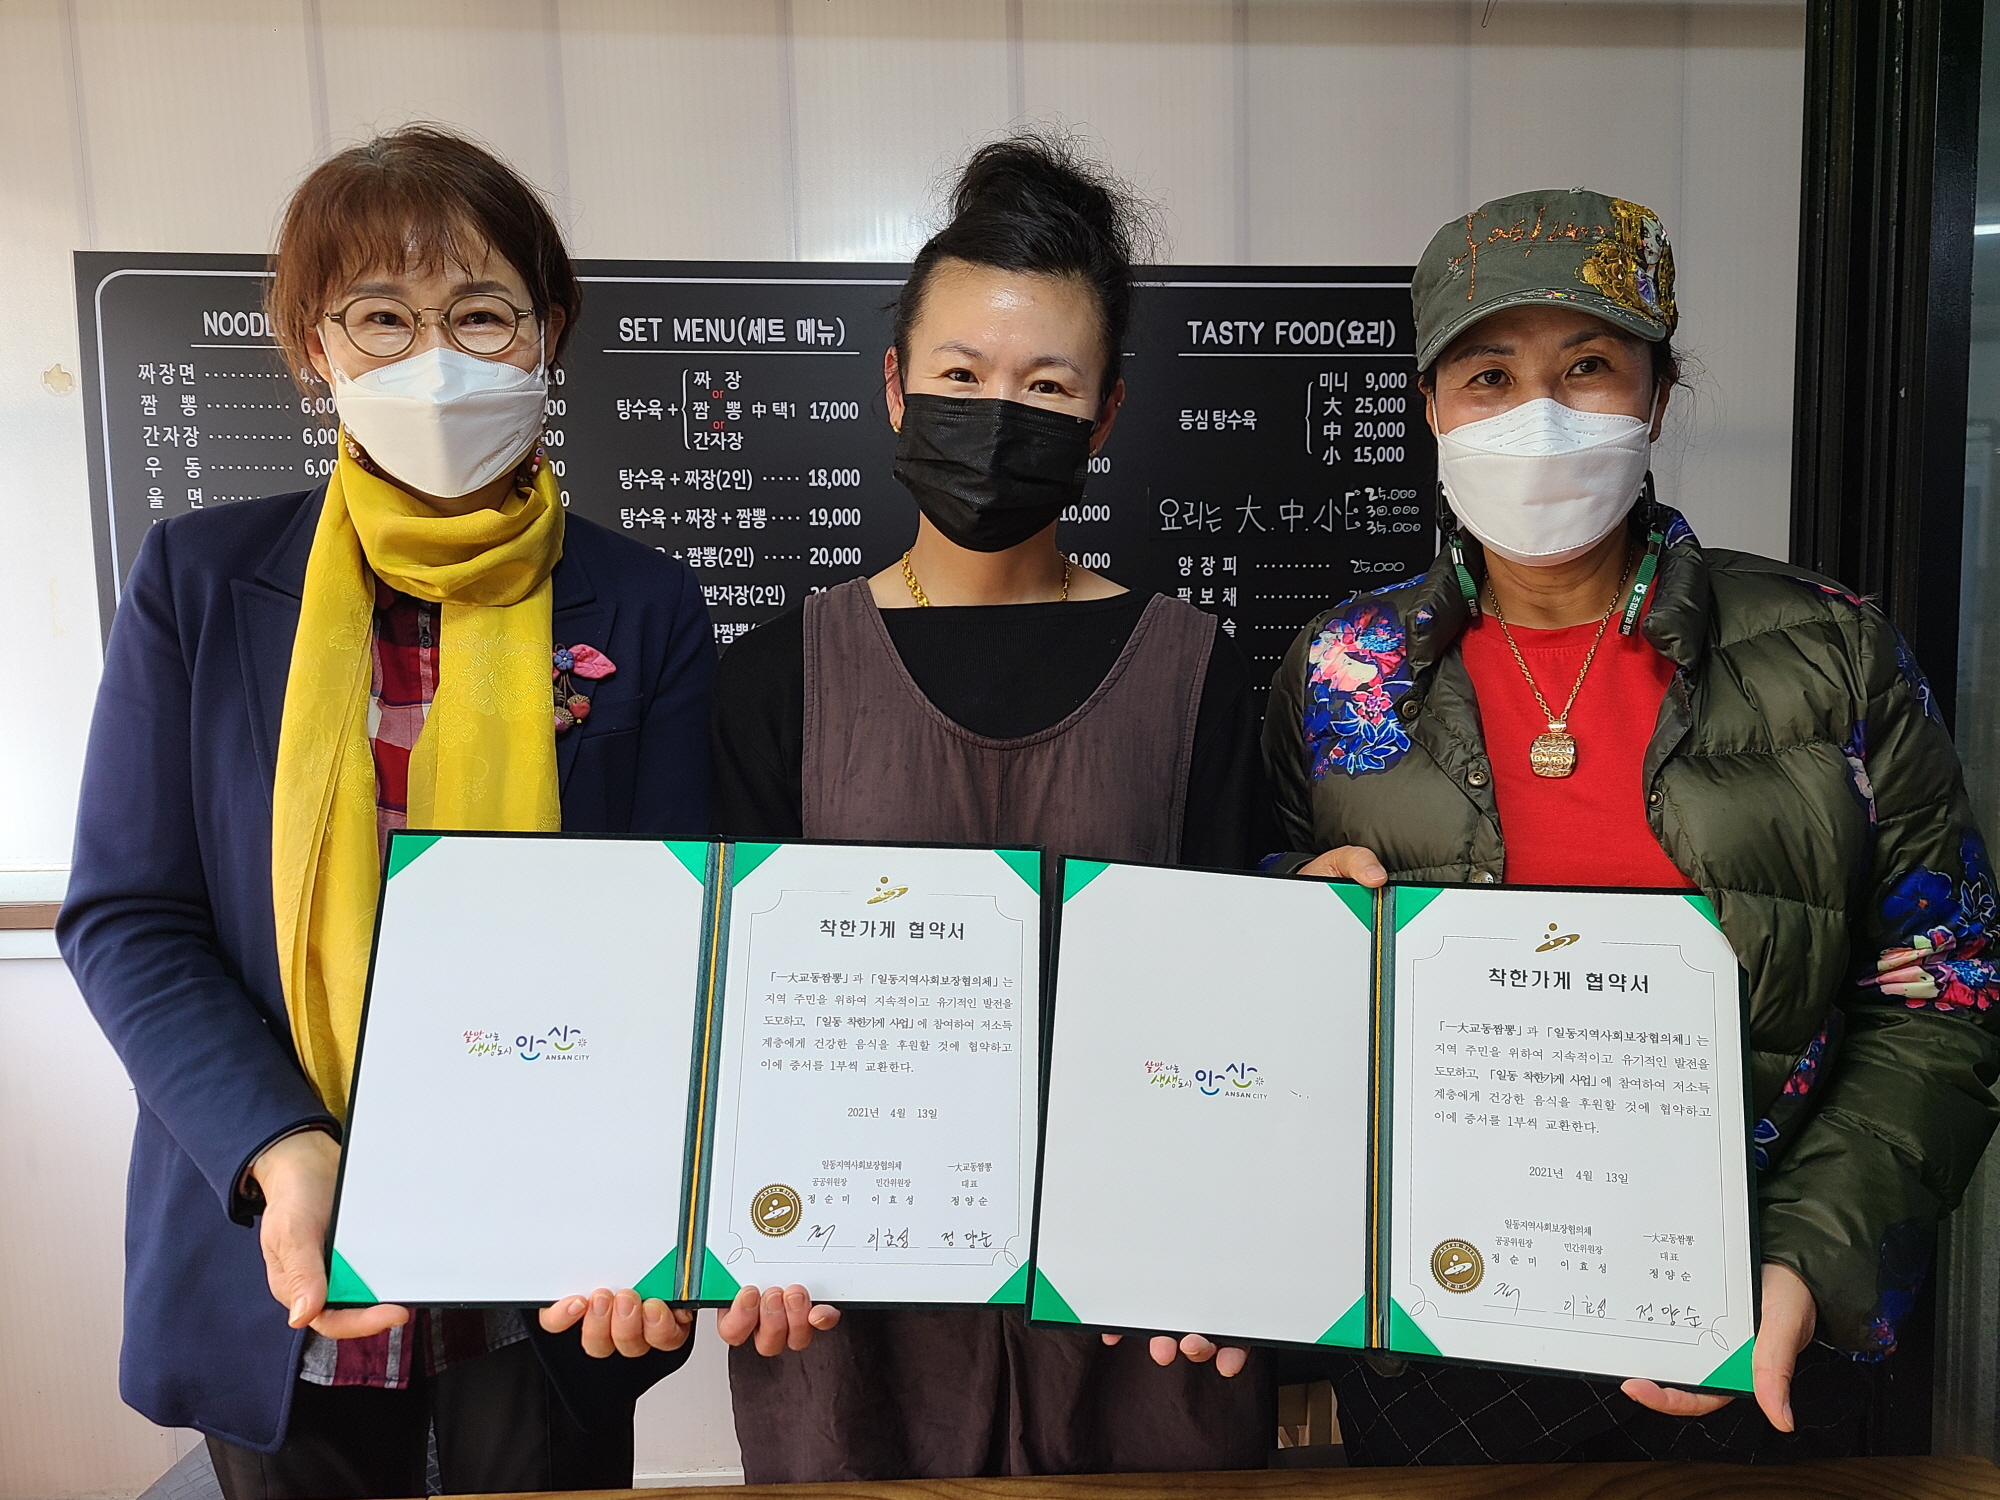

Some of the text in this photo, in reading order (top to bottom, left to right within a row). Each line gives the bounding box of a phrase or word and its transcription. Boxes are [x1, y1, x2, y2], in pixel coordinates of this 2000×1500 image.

[203, 311, 284, 337] NOODL
[619, 316, 845, 347] SET MENU(세트 메뉴)
[1186, 319, 1396, 348] TASTY FOOD(요리)
[138, 362, 196, 385] 짜장면
[1319, 371, 1408, 393] 미니 9,000
[712, 388, 723, 399] or
[300, 397, 336, 415] 6,00
[616, 398, 664, 421] 탕수육
[751, 401, 767, 419] 中
[772, 401, 796, 420] 택1
[809, 401, 859, 423] 17,000
[1323, 396, 1406, 417] 大 25,000
[713, 419, 724, 430] or
[1178, 409, 1258, 431] 등심 탕수육
[143, 425, 200, 448] 간자장
[693, 431, 744, 451] 간자장
[1323, 421, 1406, 442] 中 20,000
[1322, 445, 1405, 466] 小 15,000
[619, 468, 861, 491] 탕수육 짜장(2인) 18,000
[1364, 487, 1417, 501] 25.000
[620, 507, 861, 530] 탕수육 짜장 짬뽕 19,000
[1060, 505, 1110, 524] 10,000
[1159, 498, 1224, 534] 요리는
[1366, 521, 1421, 534] 35.000
[686, 546, 862, 569] 짬뽕(2인) 20,000
[1350, 559, 1405, 573] 25.000
[701, 585, 786, 606] 반자장(2인)
[819, 919, 964, 941] 착한가게 협약서
[1488, 967, 1649, 994] 착한가게 협약서
[764, 992, 1014, 1010] 지역 주민을 위하여 지속적이고 유기적인 발전을
[762, 1014, 806, 1027] 도모하고,
[846, 1016, 885, 1029] 착한가게
[932, 1018, 975, 1031] 참여하여
[980, 1019, 1013, 1032] 저소득
[463, 1031, 484, 1043] 살맛
[761, 1036, 1013, 1053] 계층에게 건강한 음식을 후원할 것에 협약하고
[760, 1058, 914, 1074] 이에 증서를 1부씩 교환한다.
[1434, 1042, 1711, 1071] 지역 주민을 위하여 지속적이고 유기적인 발전을
[1145, 1061, 1164, 1073] 살맛
[1434, 1066, 1479, 1080] 도모하고,
[1522, 1070, 1565, 1086] 착한가게
[1618, 1076, 1665, 1092] 참여하여
[1672, 1080, 1711, 1095] 저소득
[1433, 1087, 1712, 1118] 계층에게 건강한 음식을 후원할 것에 협약하고
[847, 1107, 938, 1120] 2021년 4월 13일
[1434, 1110, 1600, 1134] 이에 증서를 1부씩 교환한다.
[811, 1177, 848, 1187] 공공위원장
[875, 1177, 912, 1188] 민간위원장
[961, 1178, 979, 1189] 대표
[1529, 1166, 1629, 1185] 2021년 4월 13일
[1494, 1236, 1534, 1249] 공공위원장
[1563, 1242, 1604, 1256] 민간위원장
[1659, 1251, 1680, 1262] 대표
